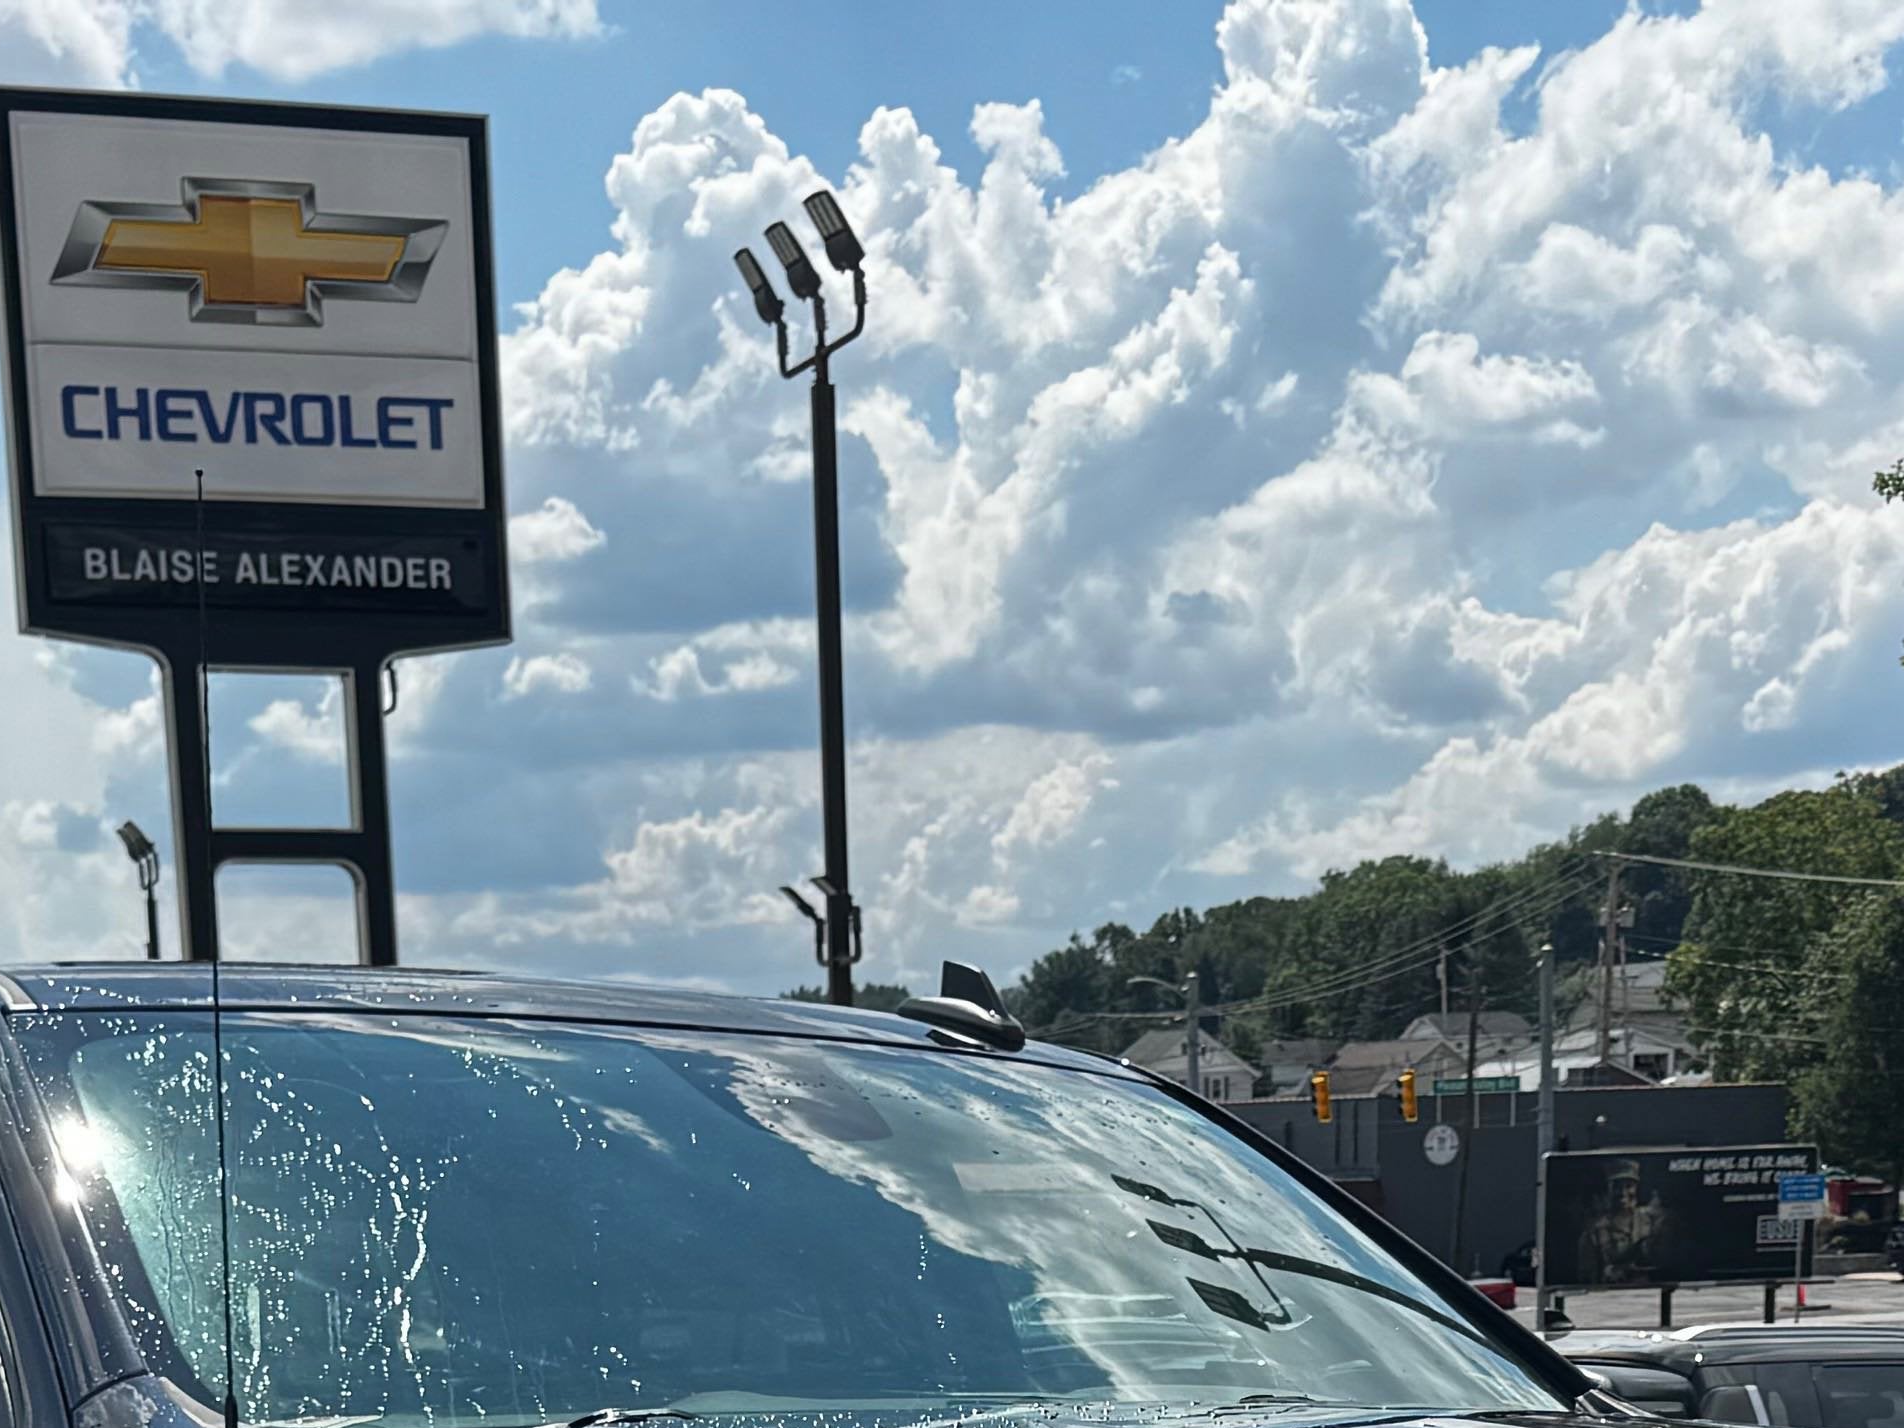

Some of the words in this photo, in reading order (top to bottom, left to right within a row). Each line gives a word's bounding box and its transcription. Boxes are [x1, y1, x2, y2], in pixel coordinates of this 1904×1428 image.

[60, 384, 454, 451] CHEVROLET
[84, 548, 220, 583] BLAISE
[235, 554, 453, 590] ALEXANDER
